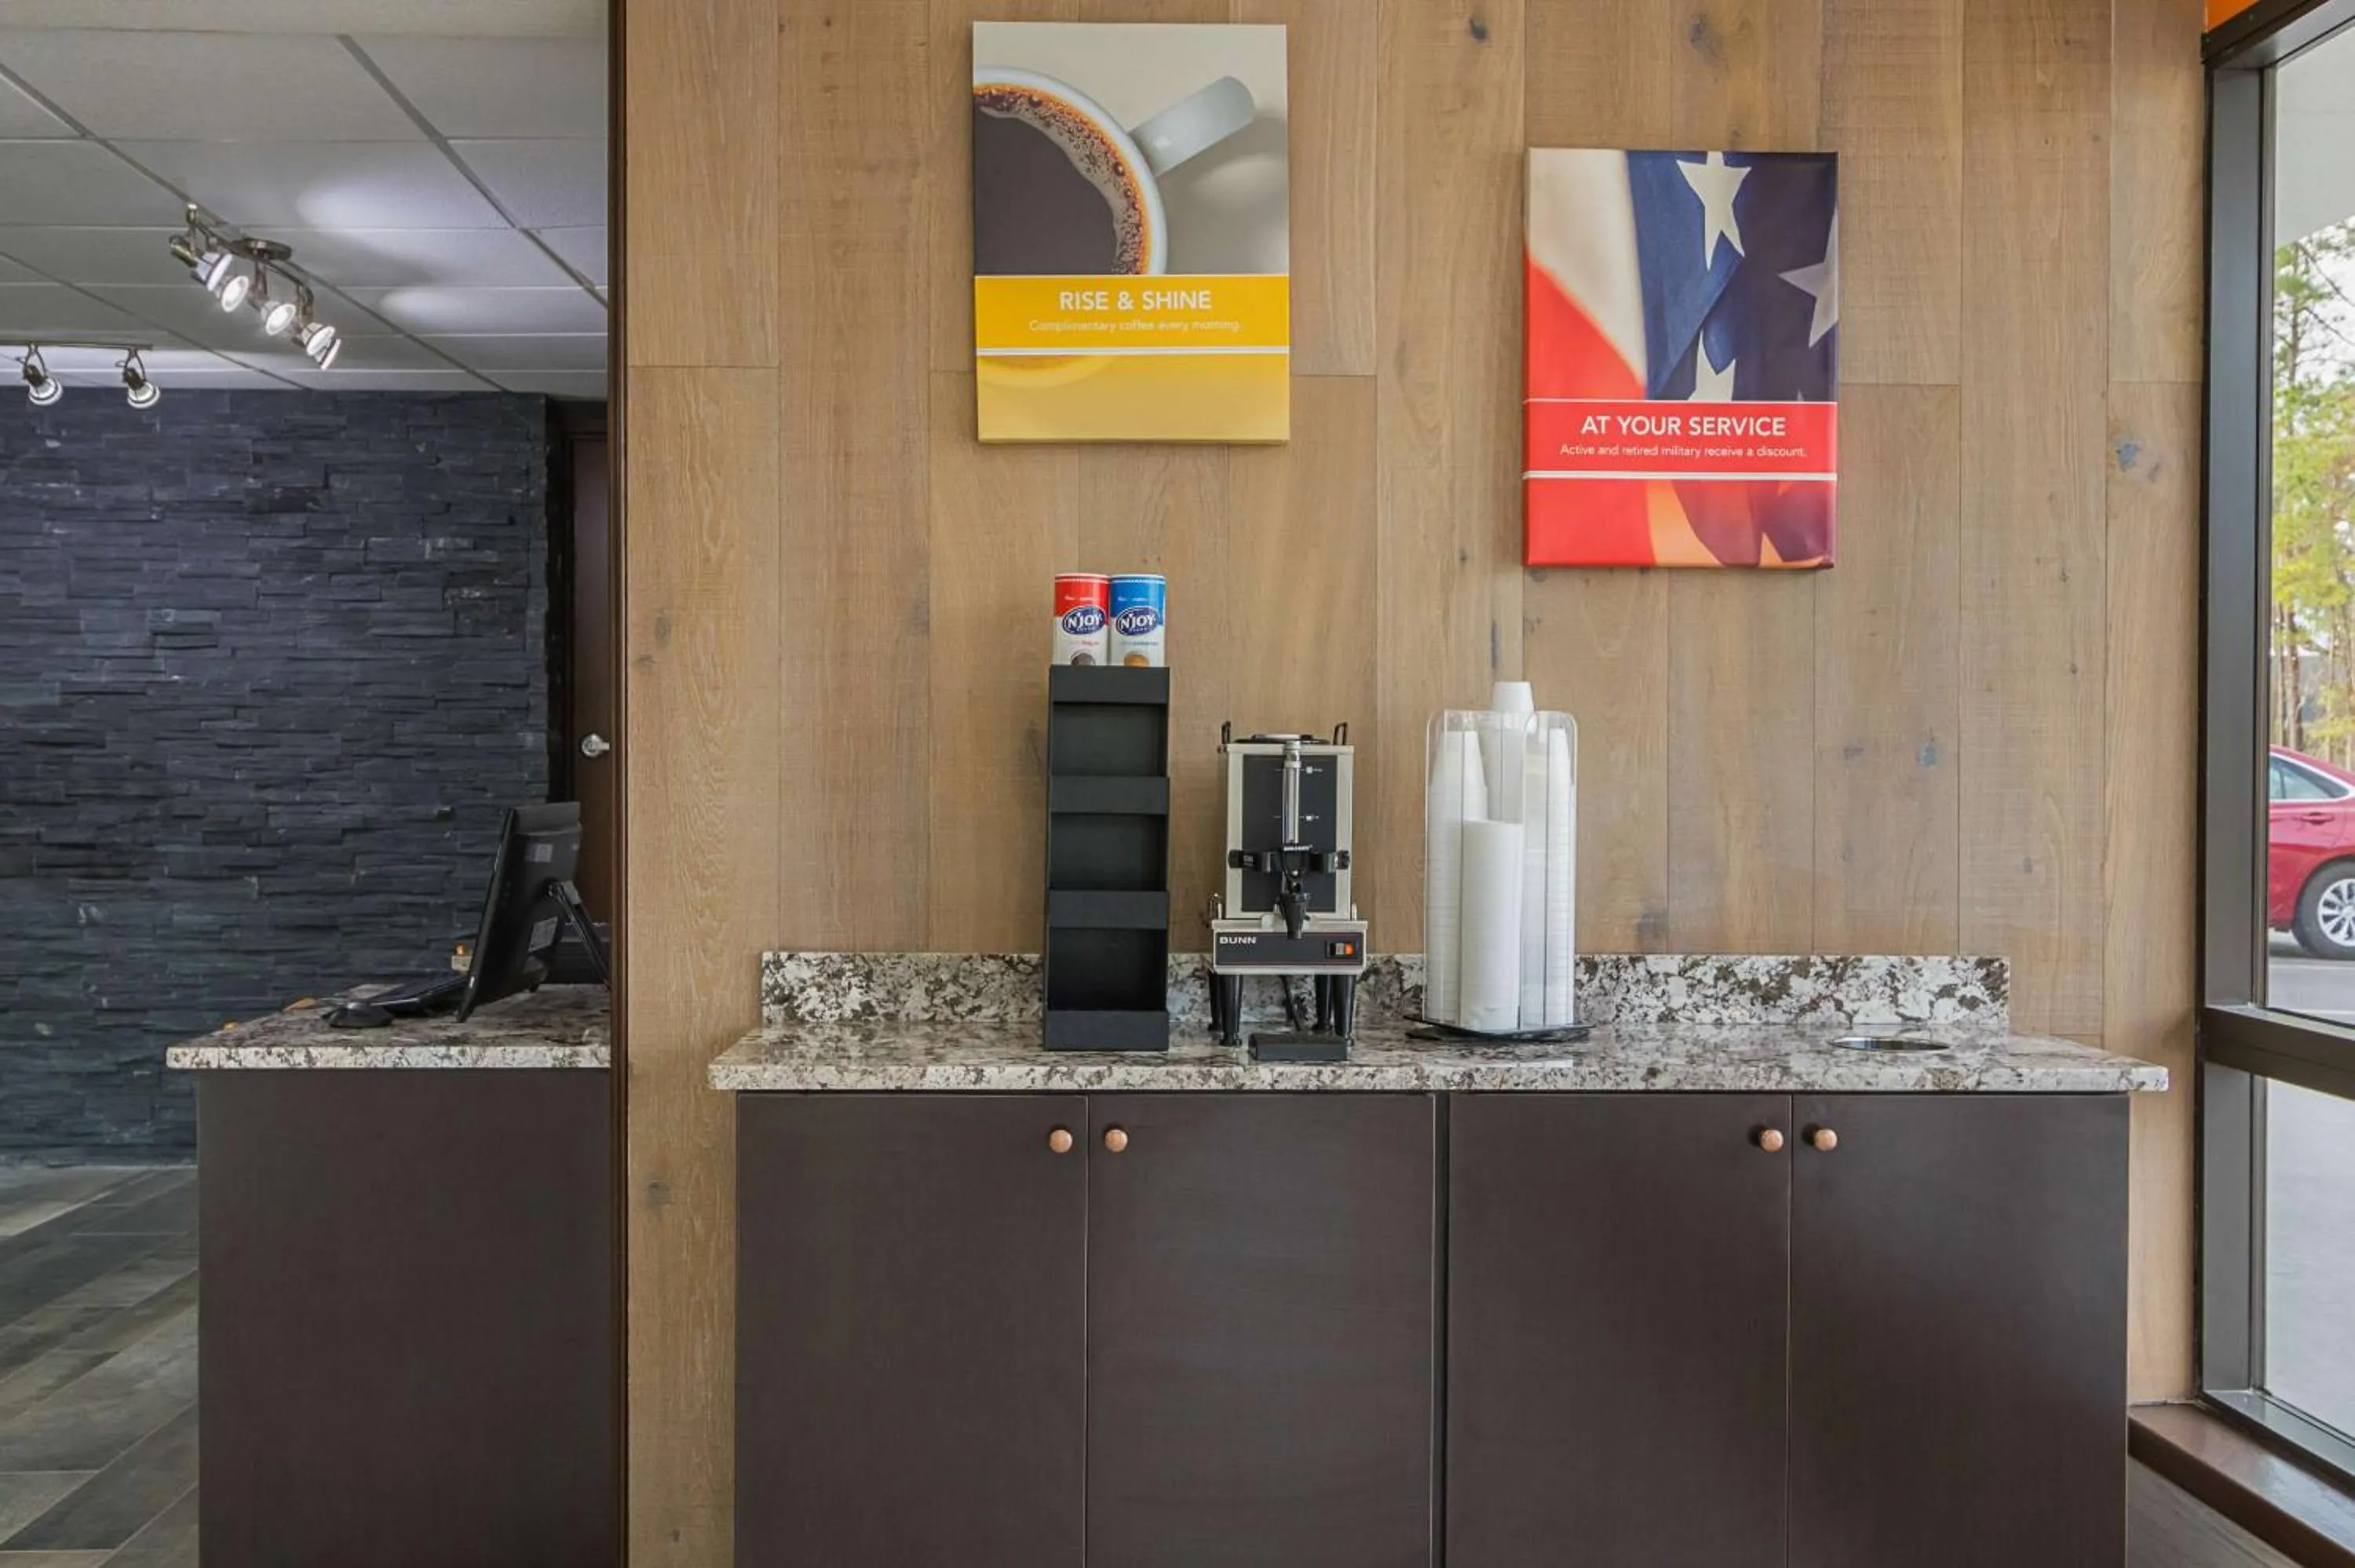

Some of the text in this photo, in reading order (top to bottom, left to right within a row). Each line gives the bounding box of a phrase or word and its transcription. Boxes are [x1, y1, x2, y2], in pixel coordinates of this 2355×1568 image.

[1059, 290, 1213, 311] RISE & SHINE
[1028, 319, 1116, 334] Complimentary
[1119, 318, 1155, 330] coffee
[1159, 321, 1189, 334] every
[1581, 415, 1787, 437] AT YOUR SERVICE
[1559, 443, 1596, 456] Active
[1597, 444, 1619, 456] and
[1623, 445, 1659, 456] retired
[1661, 445, 1701, 459] military
[1704, 446, 1743, 457] receive
[1746, 447, 1754, 457] a
